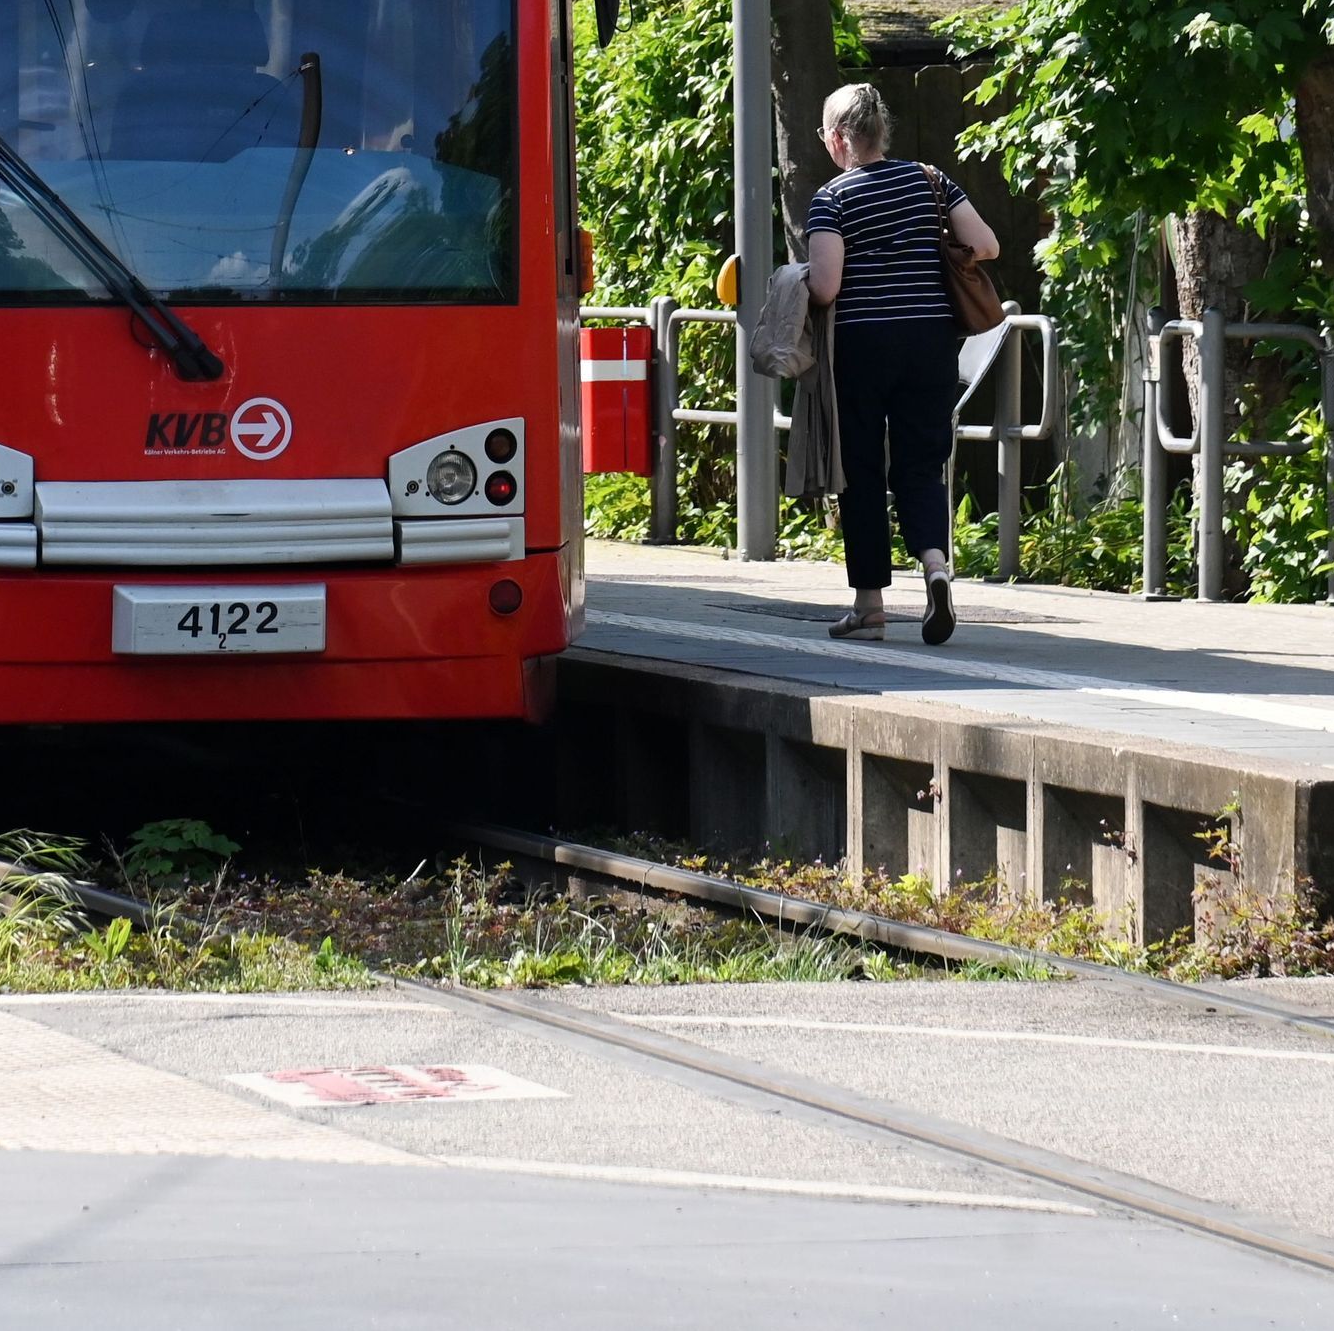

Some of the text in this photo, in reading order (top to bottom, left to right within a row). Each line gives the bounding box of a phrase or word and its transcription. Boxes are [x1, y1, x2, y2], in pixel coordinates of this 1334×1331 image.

[145, 413, 228, 448] KVB
[177, 601, 279, 638] 4122
[218, 632, 227, 649] 2
